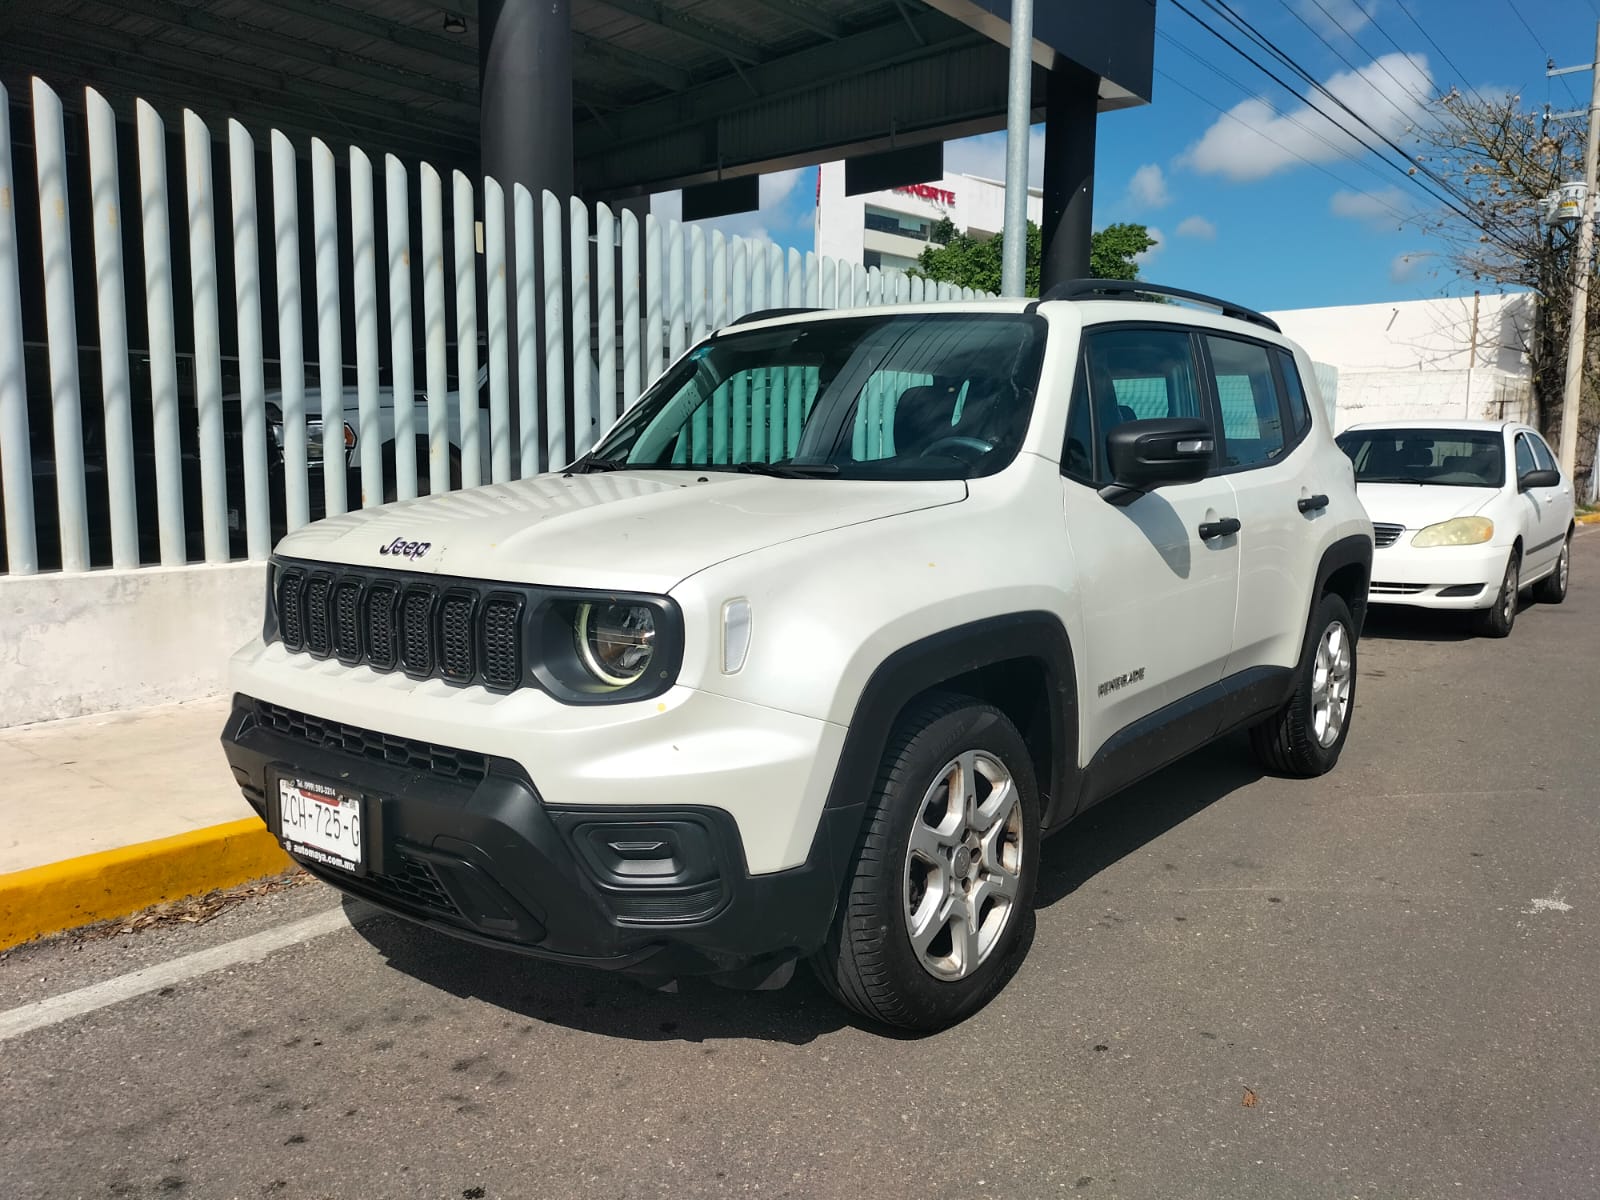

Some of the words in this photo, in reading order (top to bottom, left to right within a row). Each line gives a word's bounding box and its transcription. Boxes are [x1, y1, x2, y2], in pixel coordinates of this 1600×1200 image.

[379, 536, 431, 561] Jeep
[1097, 667, 1145, 699] RENEGADE
[281, 791, 360, 847] ZCH-725-G
[293, 843, 356, 872] automaya.com.mx
